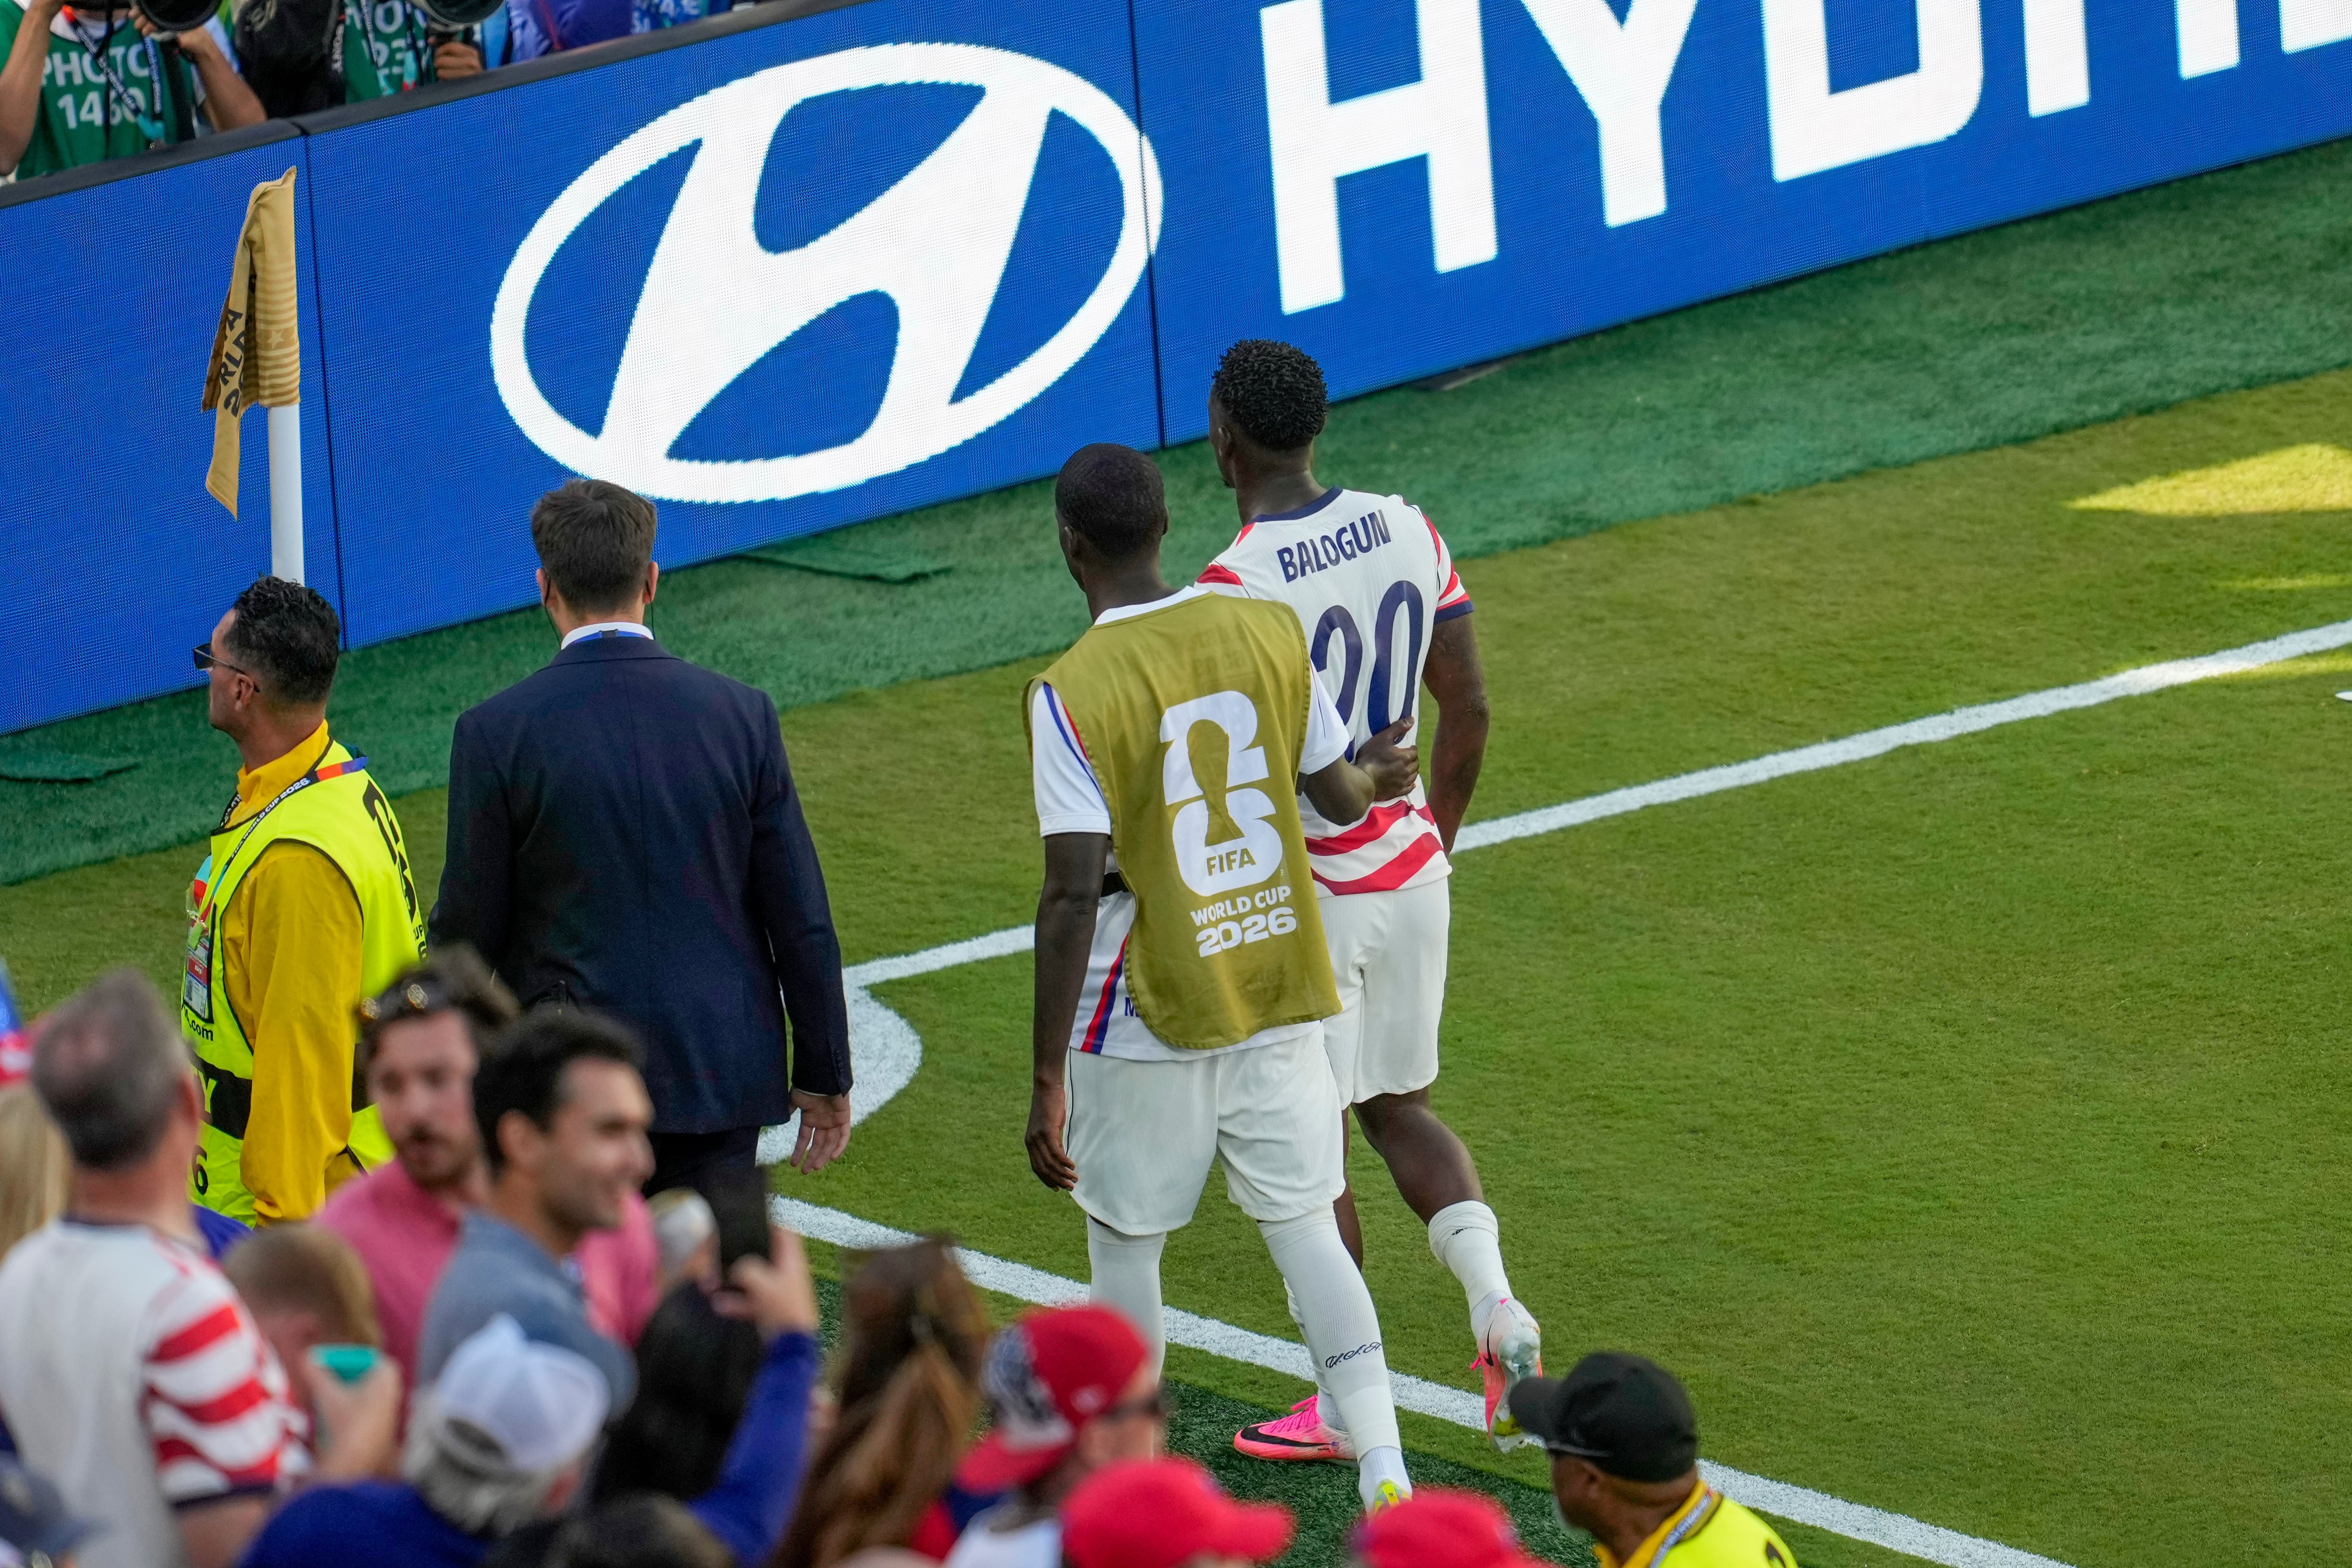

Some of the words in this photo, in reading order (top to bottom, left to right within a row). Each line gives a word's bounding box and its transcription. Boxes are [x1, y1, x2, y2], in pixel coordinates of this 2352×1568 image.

[1277, 509, 1392, 583] BALOGUN
[1310, 580, 1424, 764] 20
[265, 797, 280, 812] CUP
[280, 777, 309, 799] 2026
[1207, 848, 1256, 876] FIFA
[1190, 896, 1252, 926] WORLD
[1254, 885, 1291, 908] CUP
[413, 924, 423, 941] UP
[1196, 907, 1297, 958] 2026
